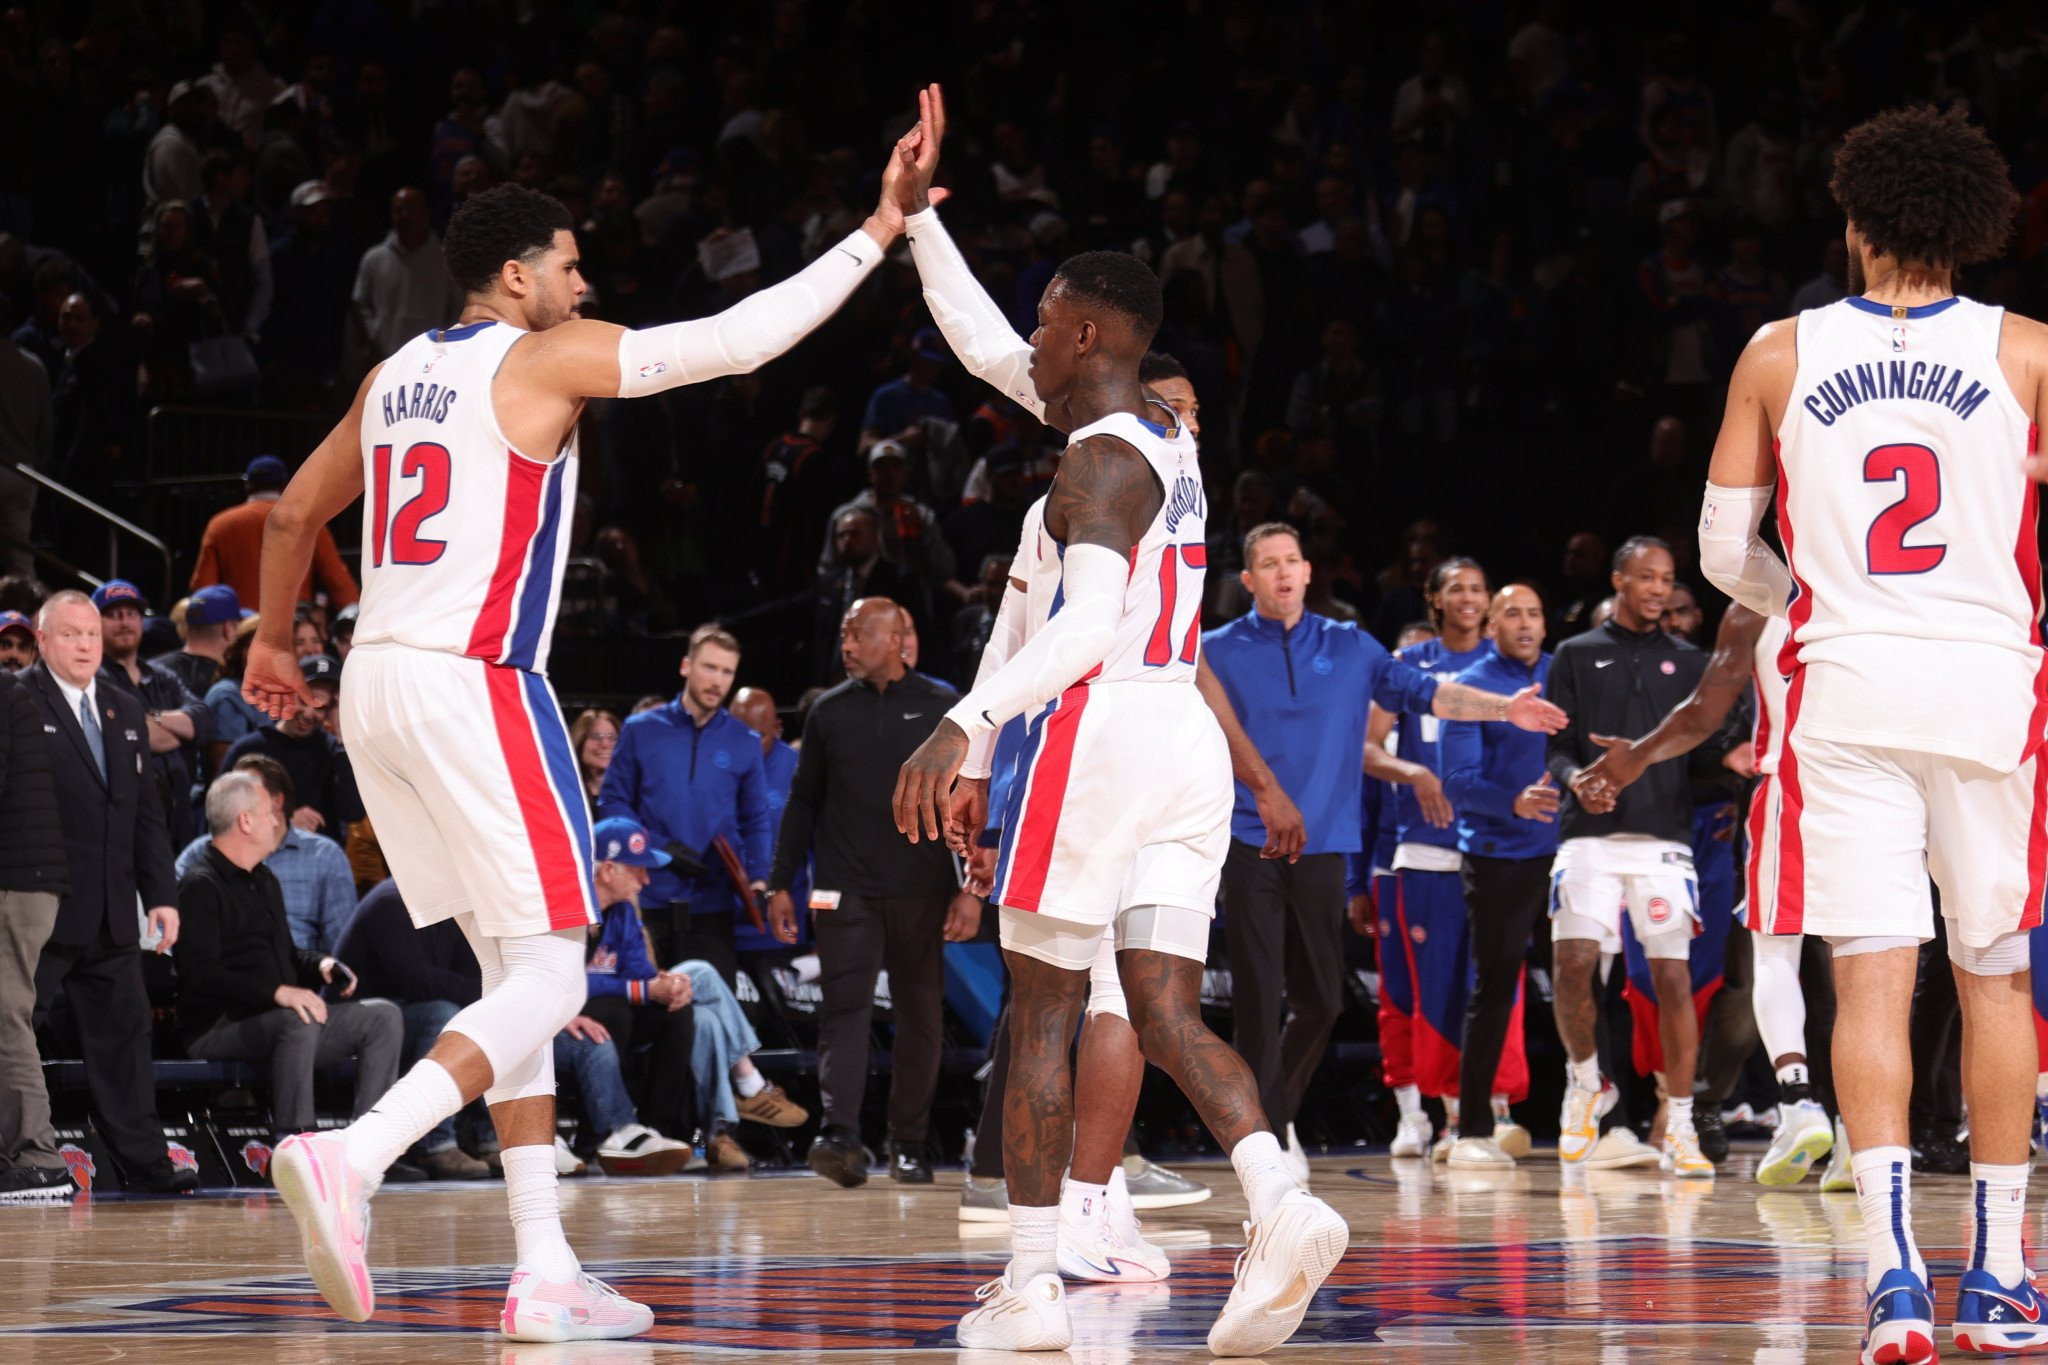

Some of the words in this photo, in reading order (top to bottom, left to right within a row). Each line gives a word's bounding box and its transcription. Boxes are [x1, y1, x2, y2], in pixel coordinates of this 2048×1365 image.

[382, 382, 457, 428] HARRIS
[1803, 360, 1991, 427] CUNNINGHAM
[372, 441, 452, 568] 12
[1863, 443, 1947, 575] 2
